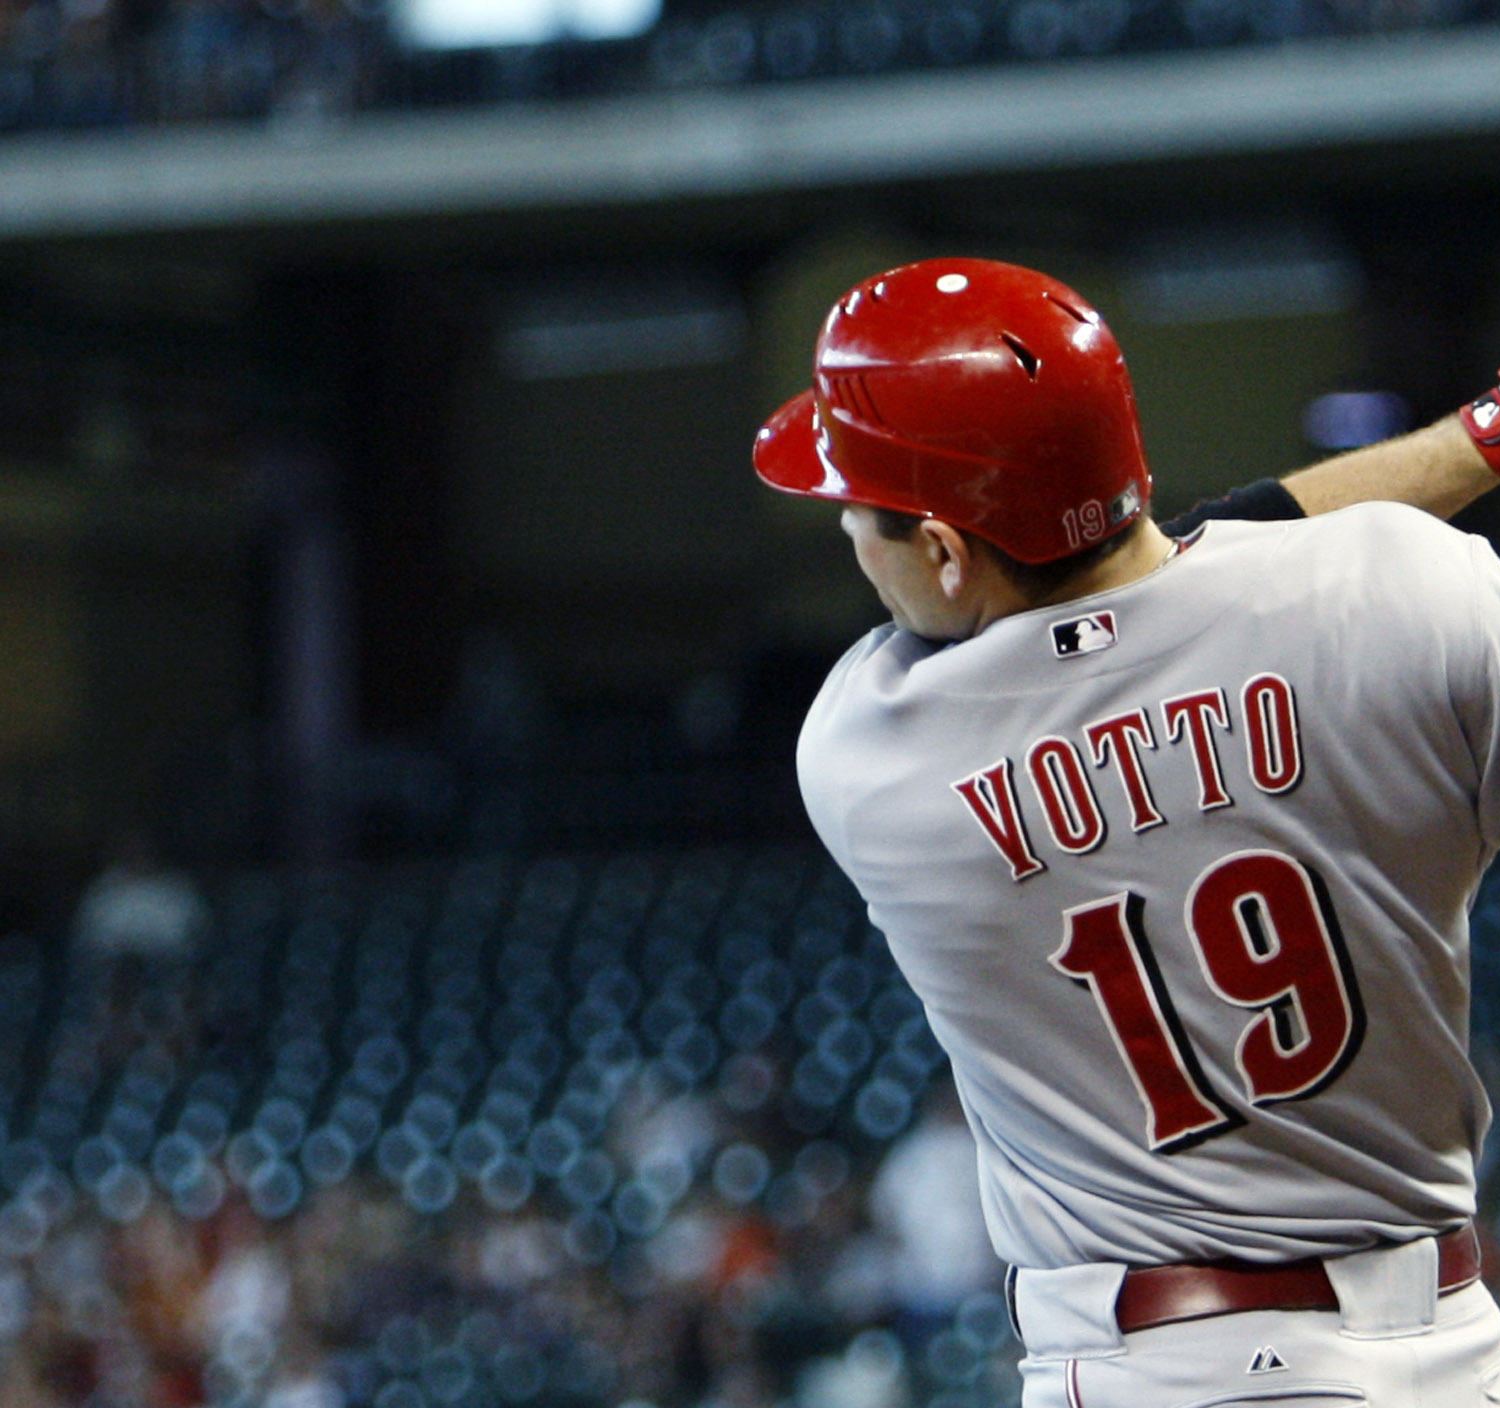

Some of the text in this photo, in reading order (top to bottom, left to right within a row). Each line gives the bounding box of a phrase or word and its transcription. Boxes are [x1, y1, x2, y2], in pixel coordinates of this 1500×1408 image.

[1062, 499, 1106, 549] 19
[950, 671, 1303, 882] VOTTO
[1047, 848, 1368, 1152] 19
